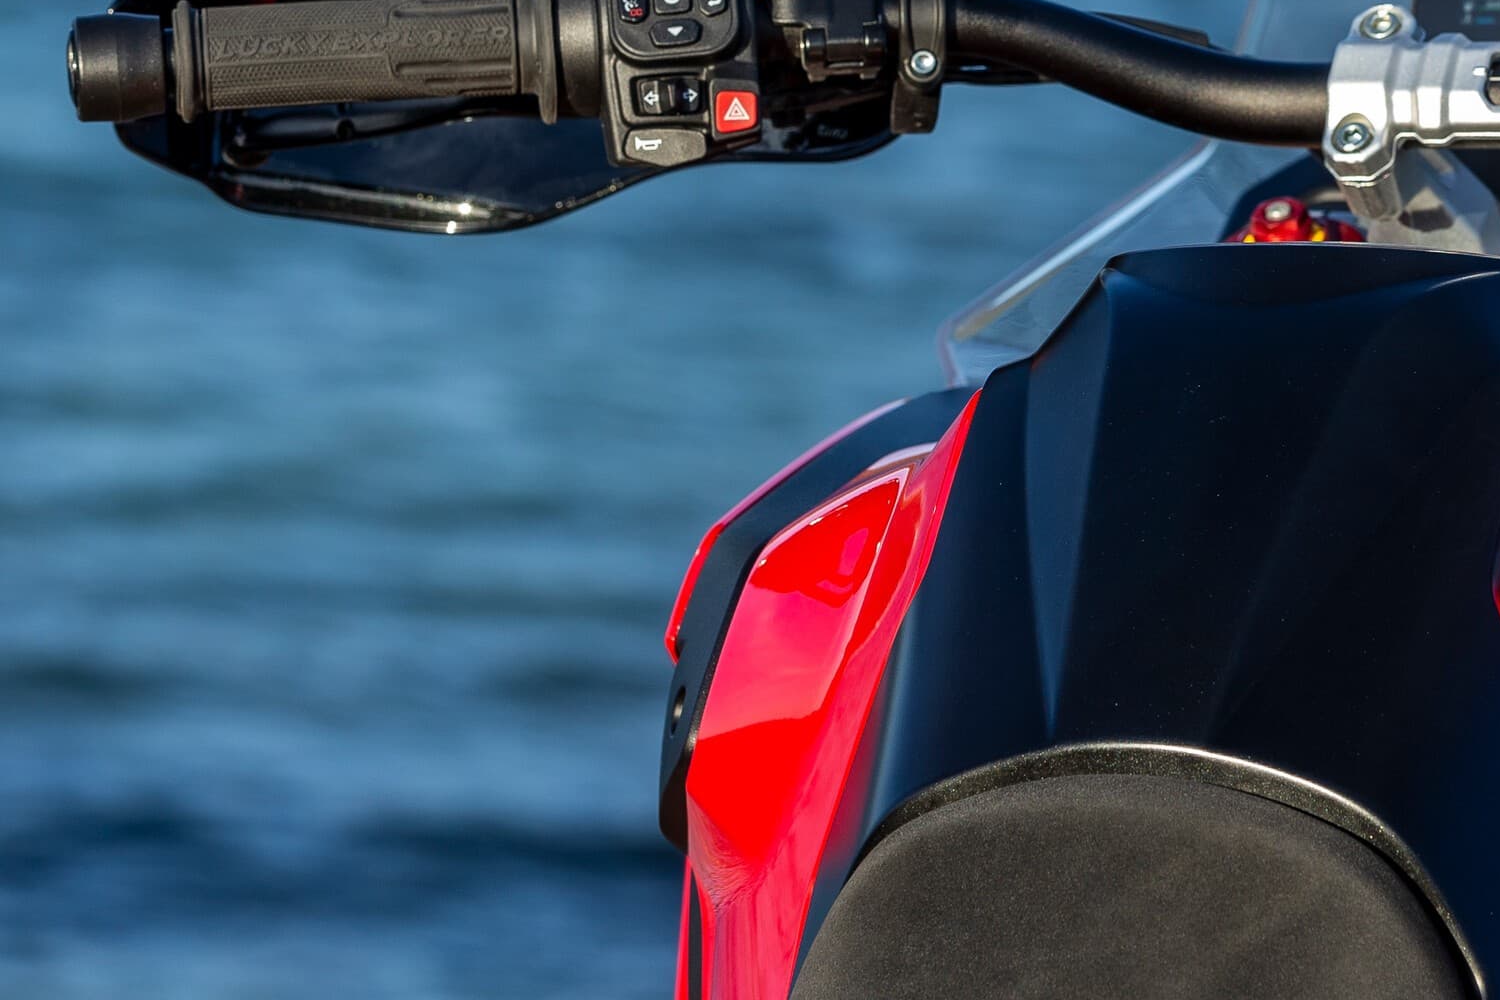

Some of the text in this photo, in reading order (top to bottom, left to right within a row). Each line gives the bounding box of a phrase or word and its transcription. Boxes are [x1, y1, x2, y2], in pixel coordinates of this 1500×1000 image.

[630, 8, 643, 17] CC
[214, 25, 510, 59] LUCKY EXPLORER
